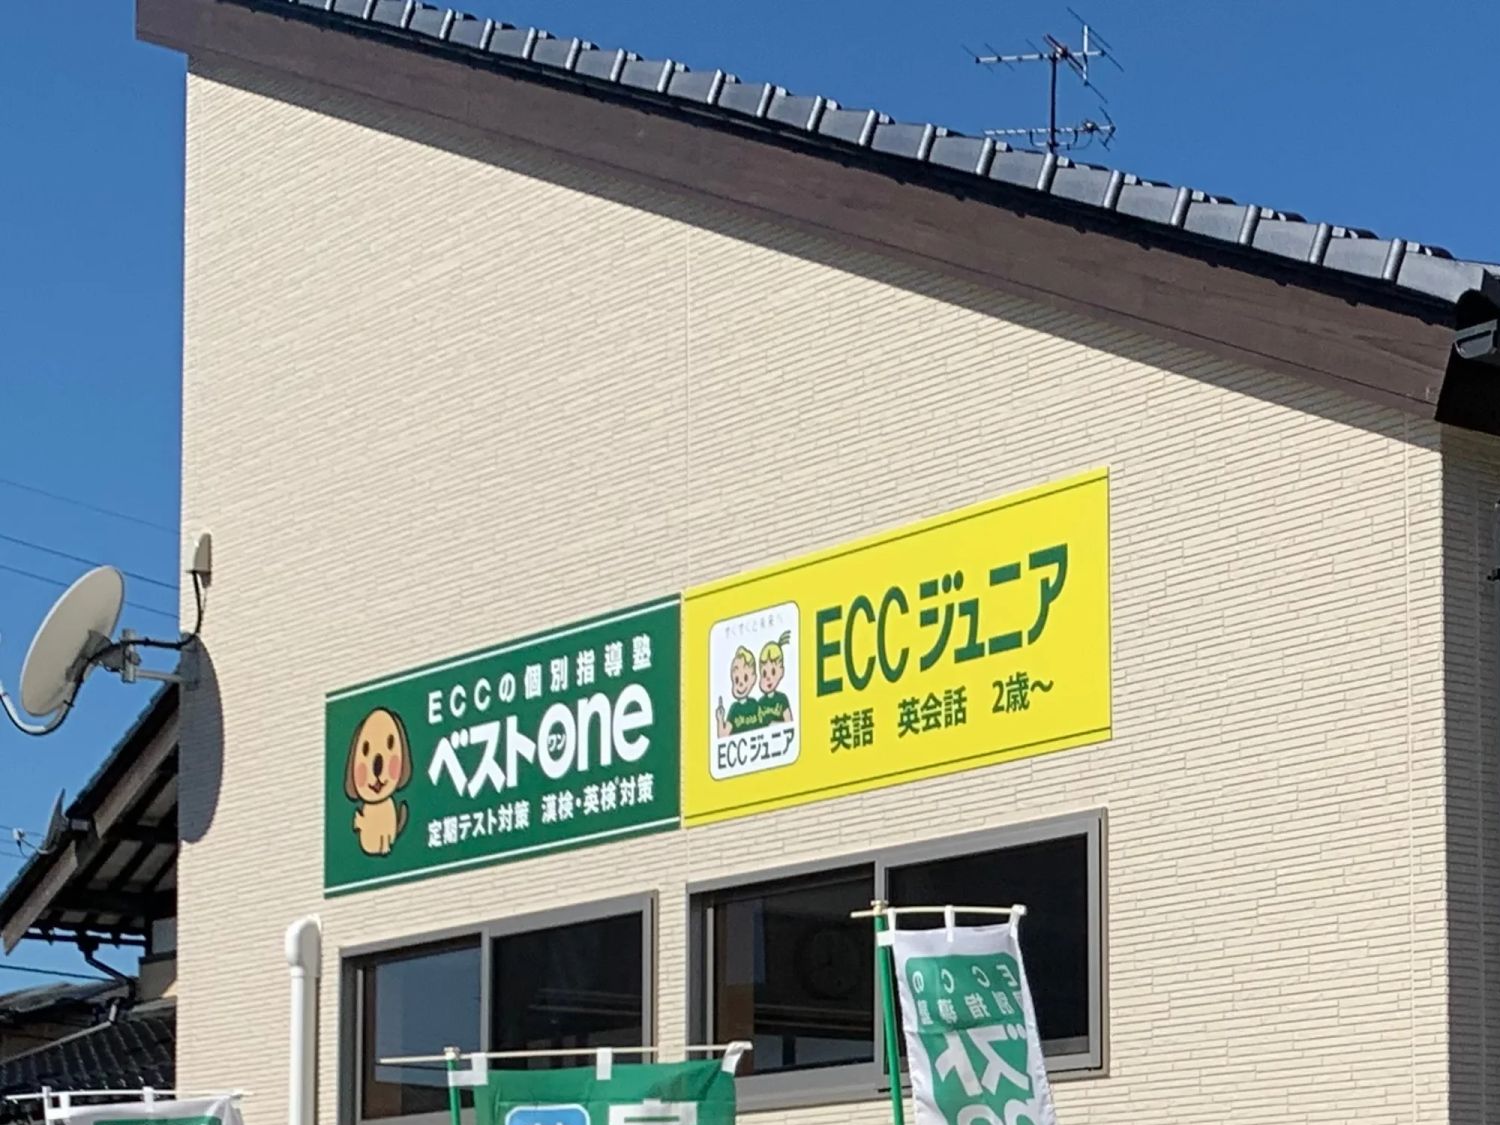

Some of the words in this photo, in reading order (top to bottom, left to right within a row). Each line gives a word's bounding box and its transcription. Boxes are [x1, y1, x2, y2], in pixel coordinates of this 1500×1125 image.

[816, 543, 1068, 698] ECCジュニア
[428, 633, 652, 724] ECCの個別指導塾
[427, 683, 654, 799] ベストone
[547, 733, 567, 752] ワン
[717, 727, 795, 769] ECCジュニア
[830, 707, 874, 753] 英語
[898, 685, 967, 738] 英会話
[427, 800, 529, 848] 定期テスト対策
